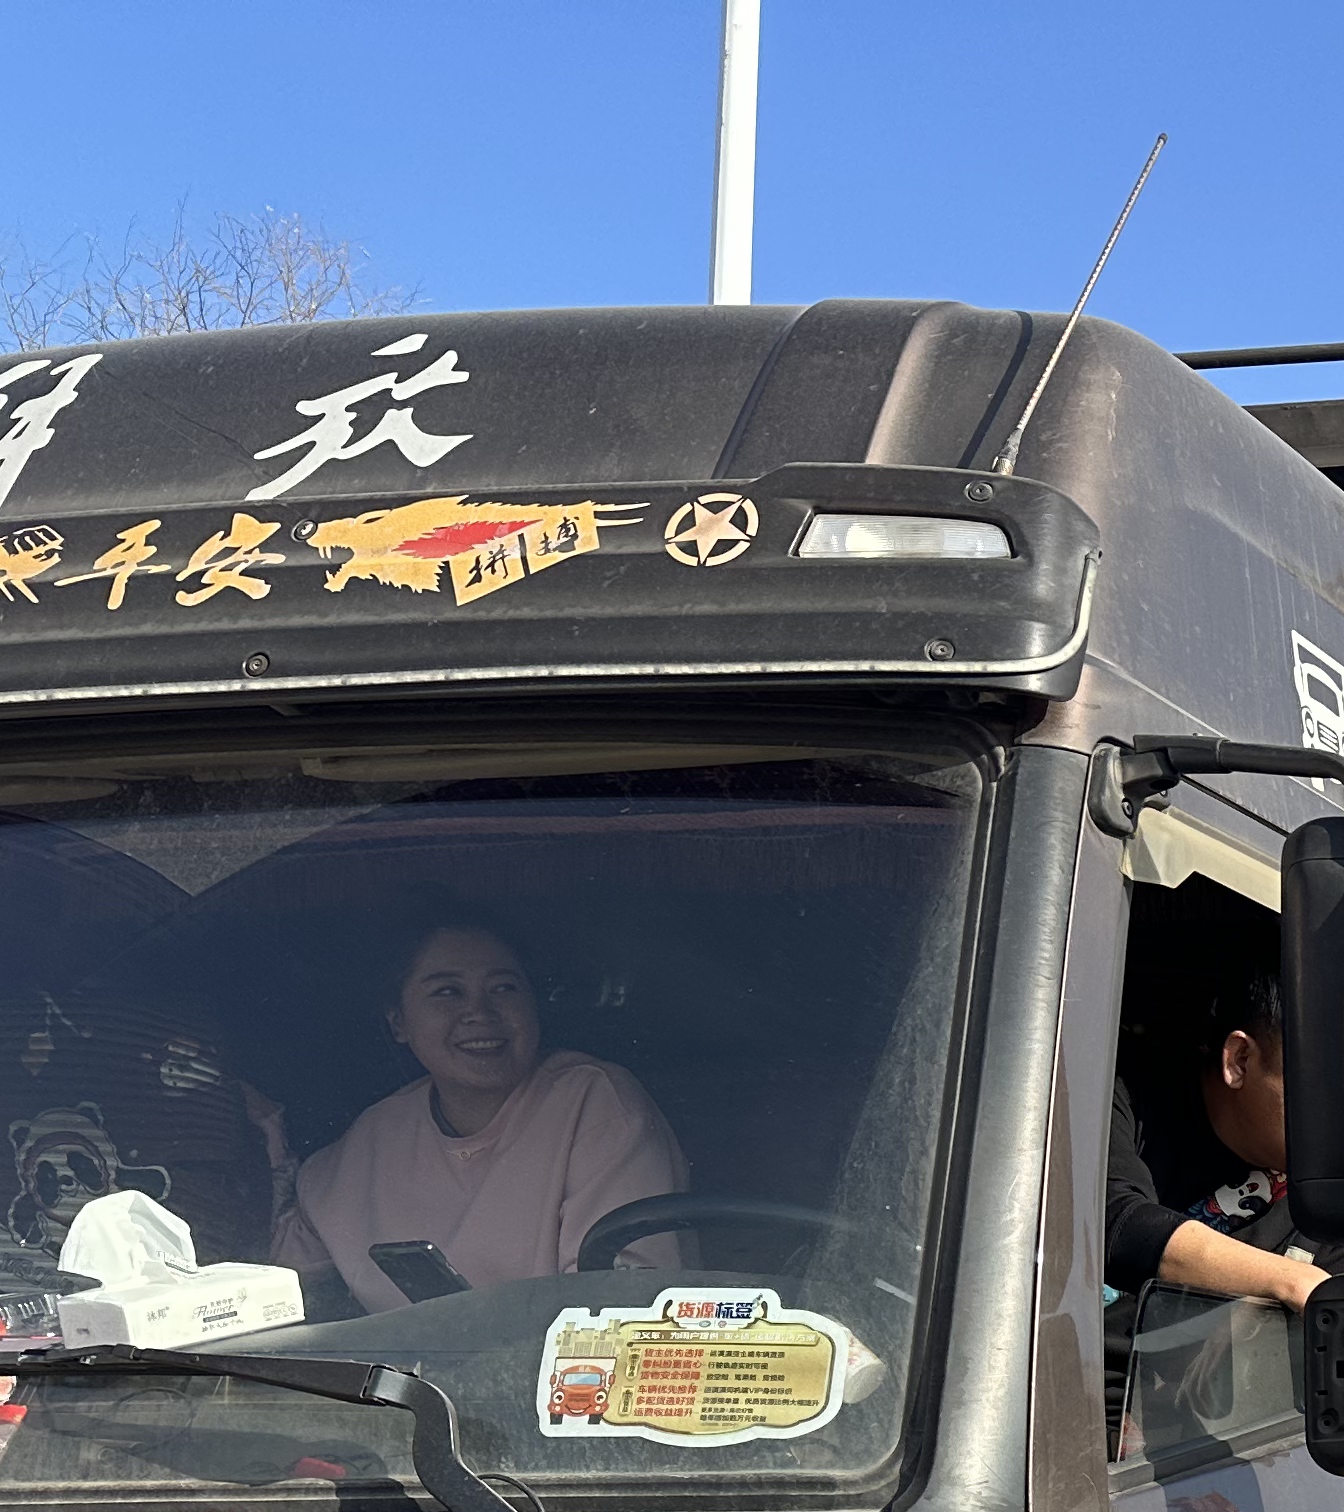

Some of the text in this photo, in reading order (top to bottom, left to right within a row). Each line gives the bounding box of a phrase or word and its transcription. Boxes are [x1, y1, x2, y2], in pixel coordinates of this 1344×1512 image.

[53, 512, 286, 610] 平安
[676, 1301, 754, 1319] 货源标签
